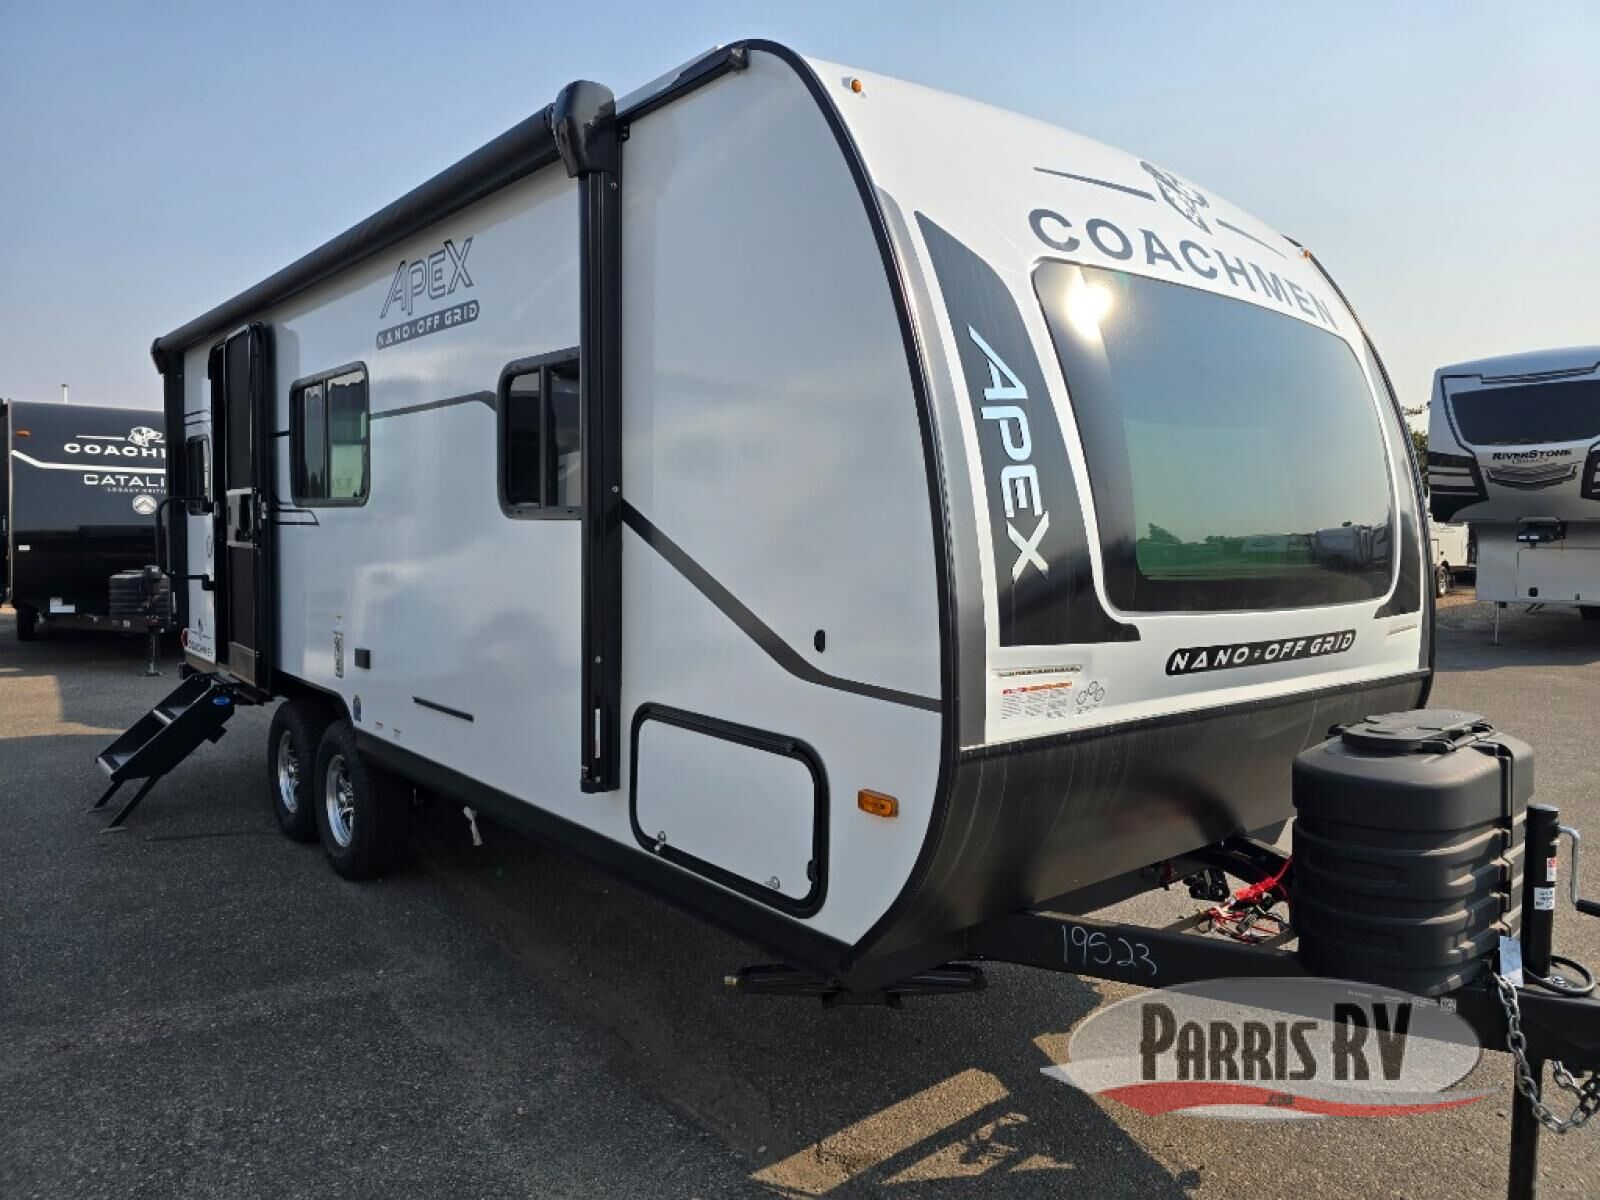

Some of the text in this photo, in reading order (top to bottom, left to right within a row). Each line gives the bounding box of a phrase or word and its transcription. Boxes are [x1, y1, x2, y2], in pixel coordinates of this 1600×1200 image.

[380, 236, 474, 319] APEX
[1028, 208, 1339, 330] COACHMEN
[444, 303, 477, 326] GRID
[63, 443, 166, 458] COACH
[967, 323, 1050, 584] APEX
[1310, 633, 1354, 654] GRID
[1061, 924, 1157, 975] 19523
